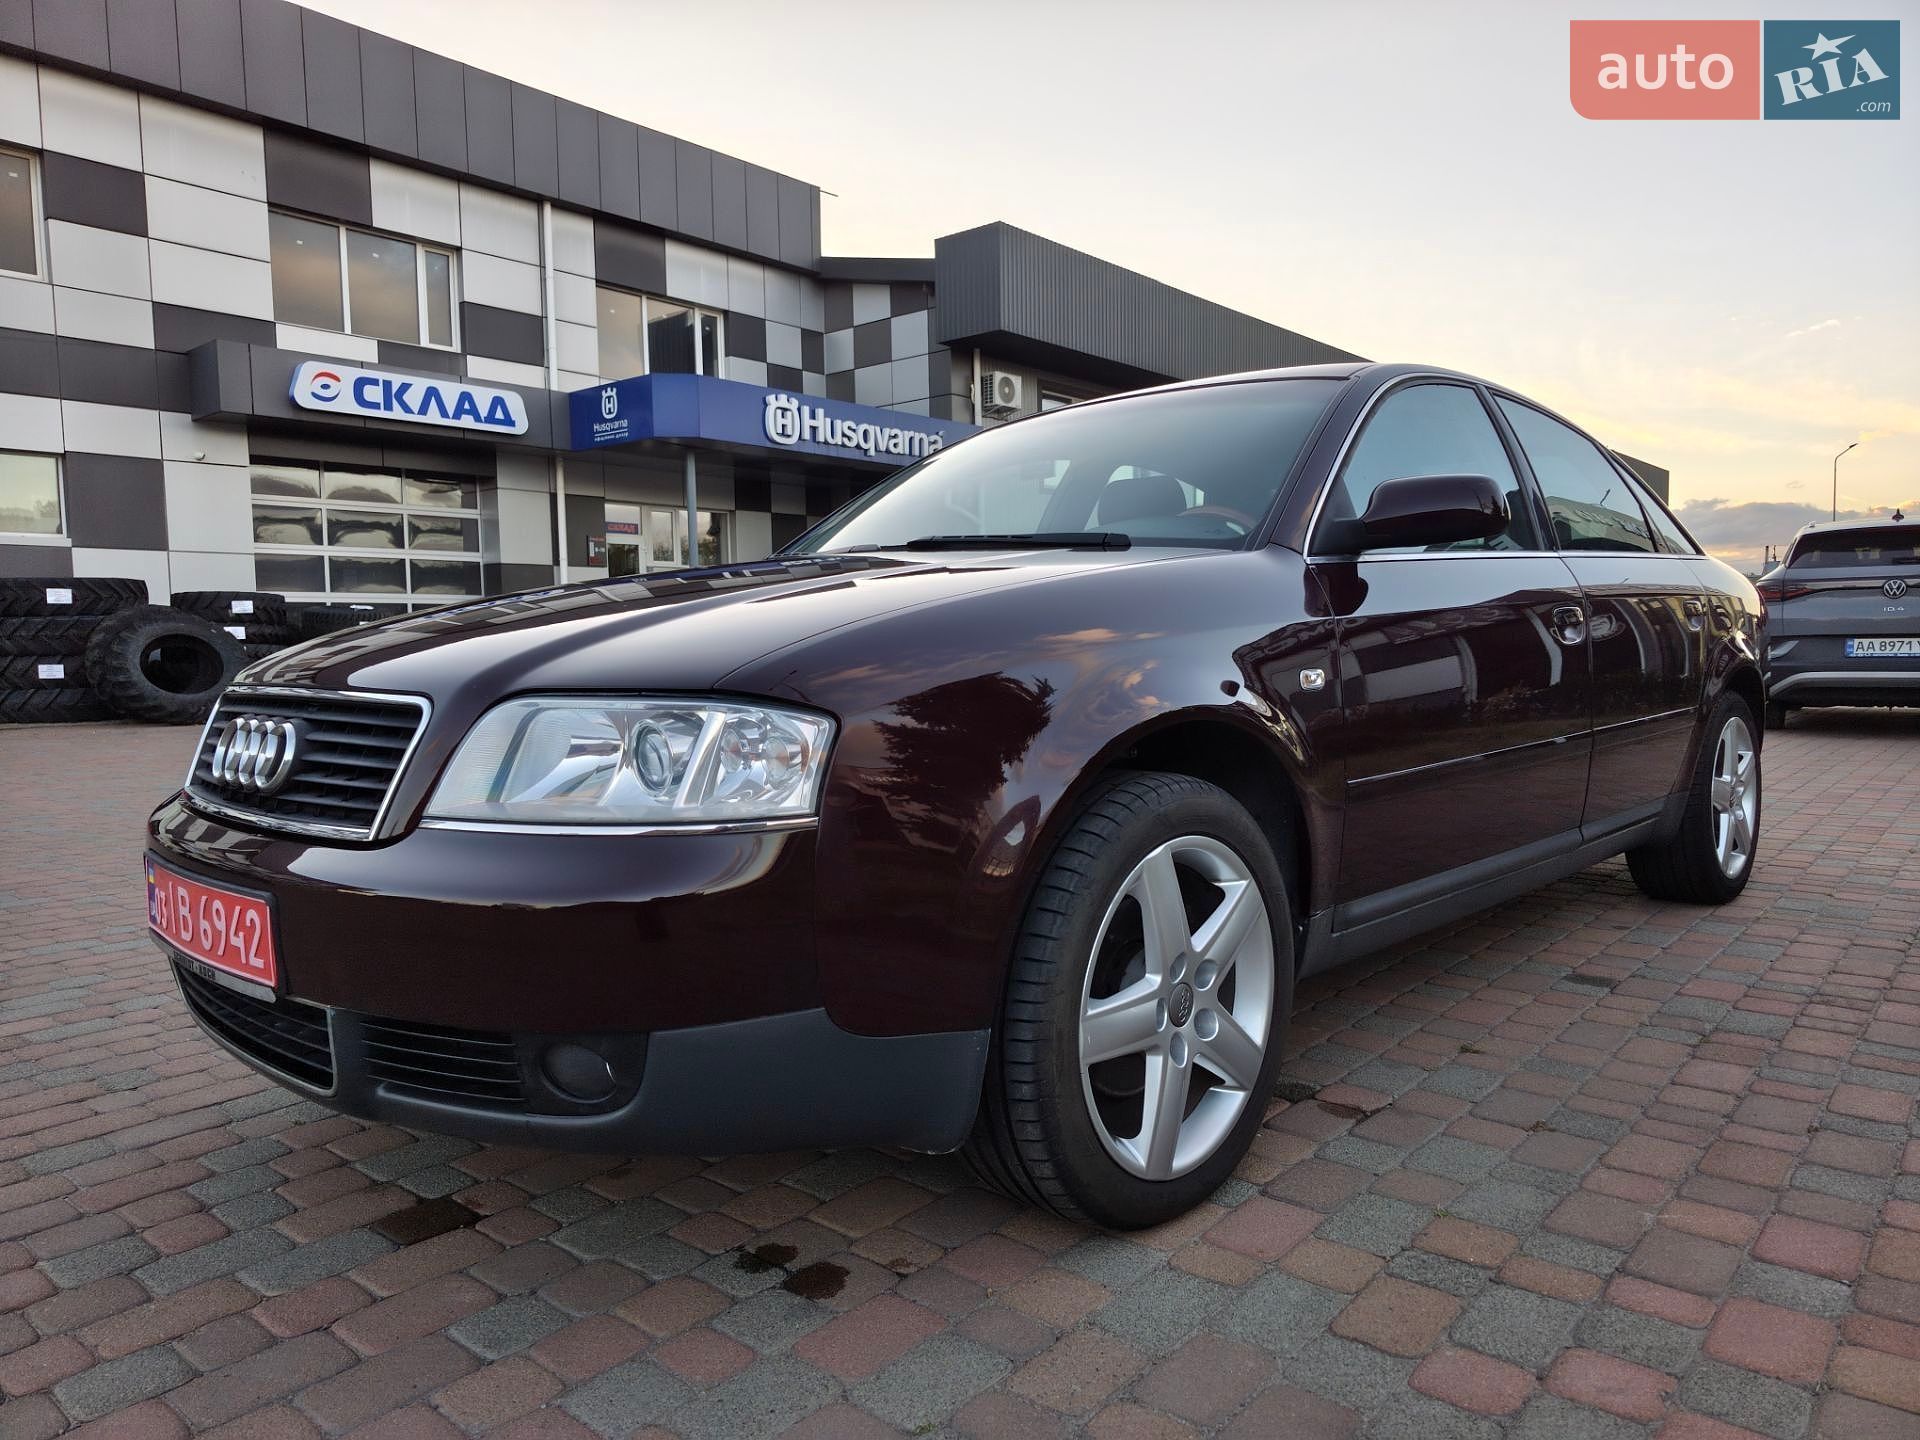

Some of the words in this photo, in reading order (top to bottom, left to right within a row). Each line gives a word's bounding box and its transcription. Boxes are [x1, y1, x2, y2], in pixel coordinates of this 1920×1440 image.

[353, 376, 516, 428] СКЛАД
[593, 419, 629, 433] Husqvarna
[800, 405, 943, 458] Husqvarna
[1855, 641, 1876, 652] AA
[1879, 640, 1913, 652] 8971
[200, 895, 265, 969] 6942
